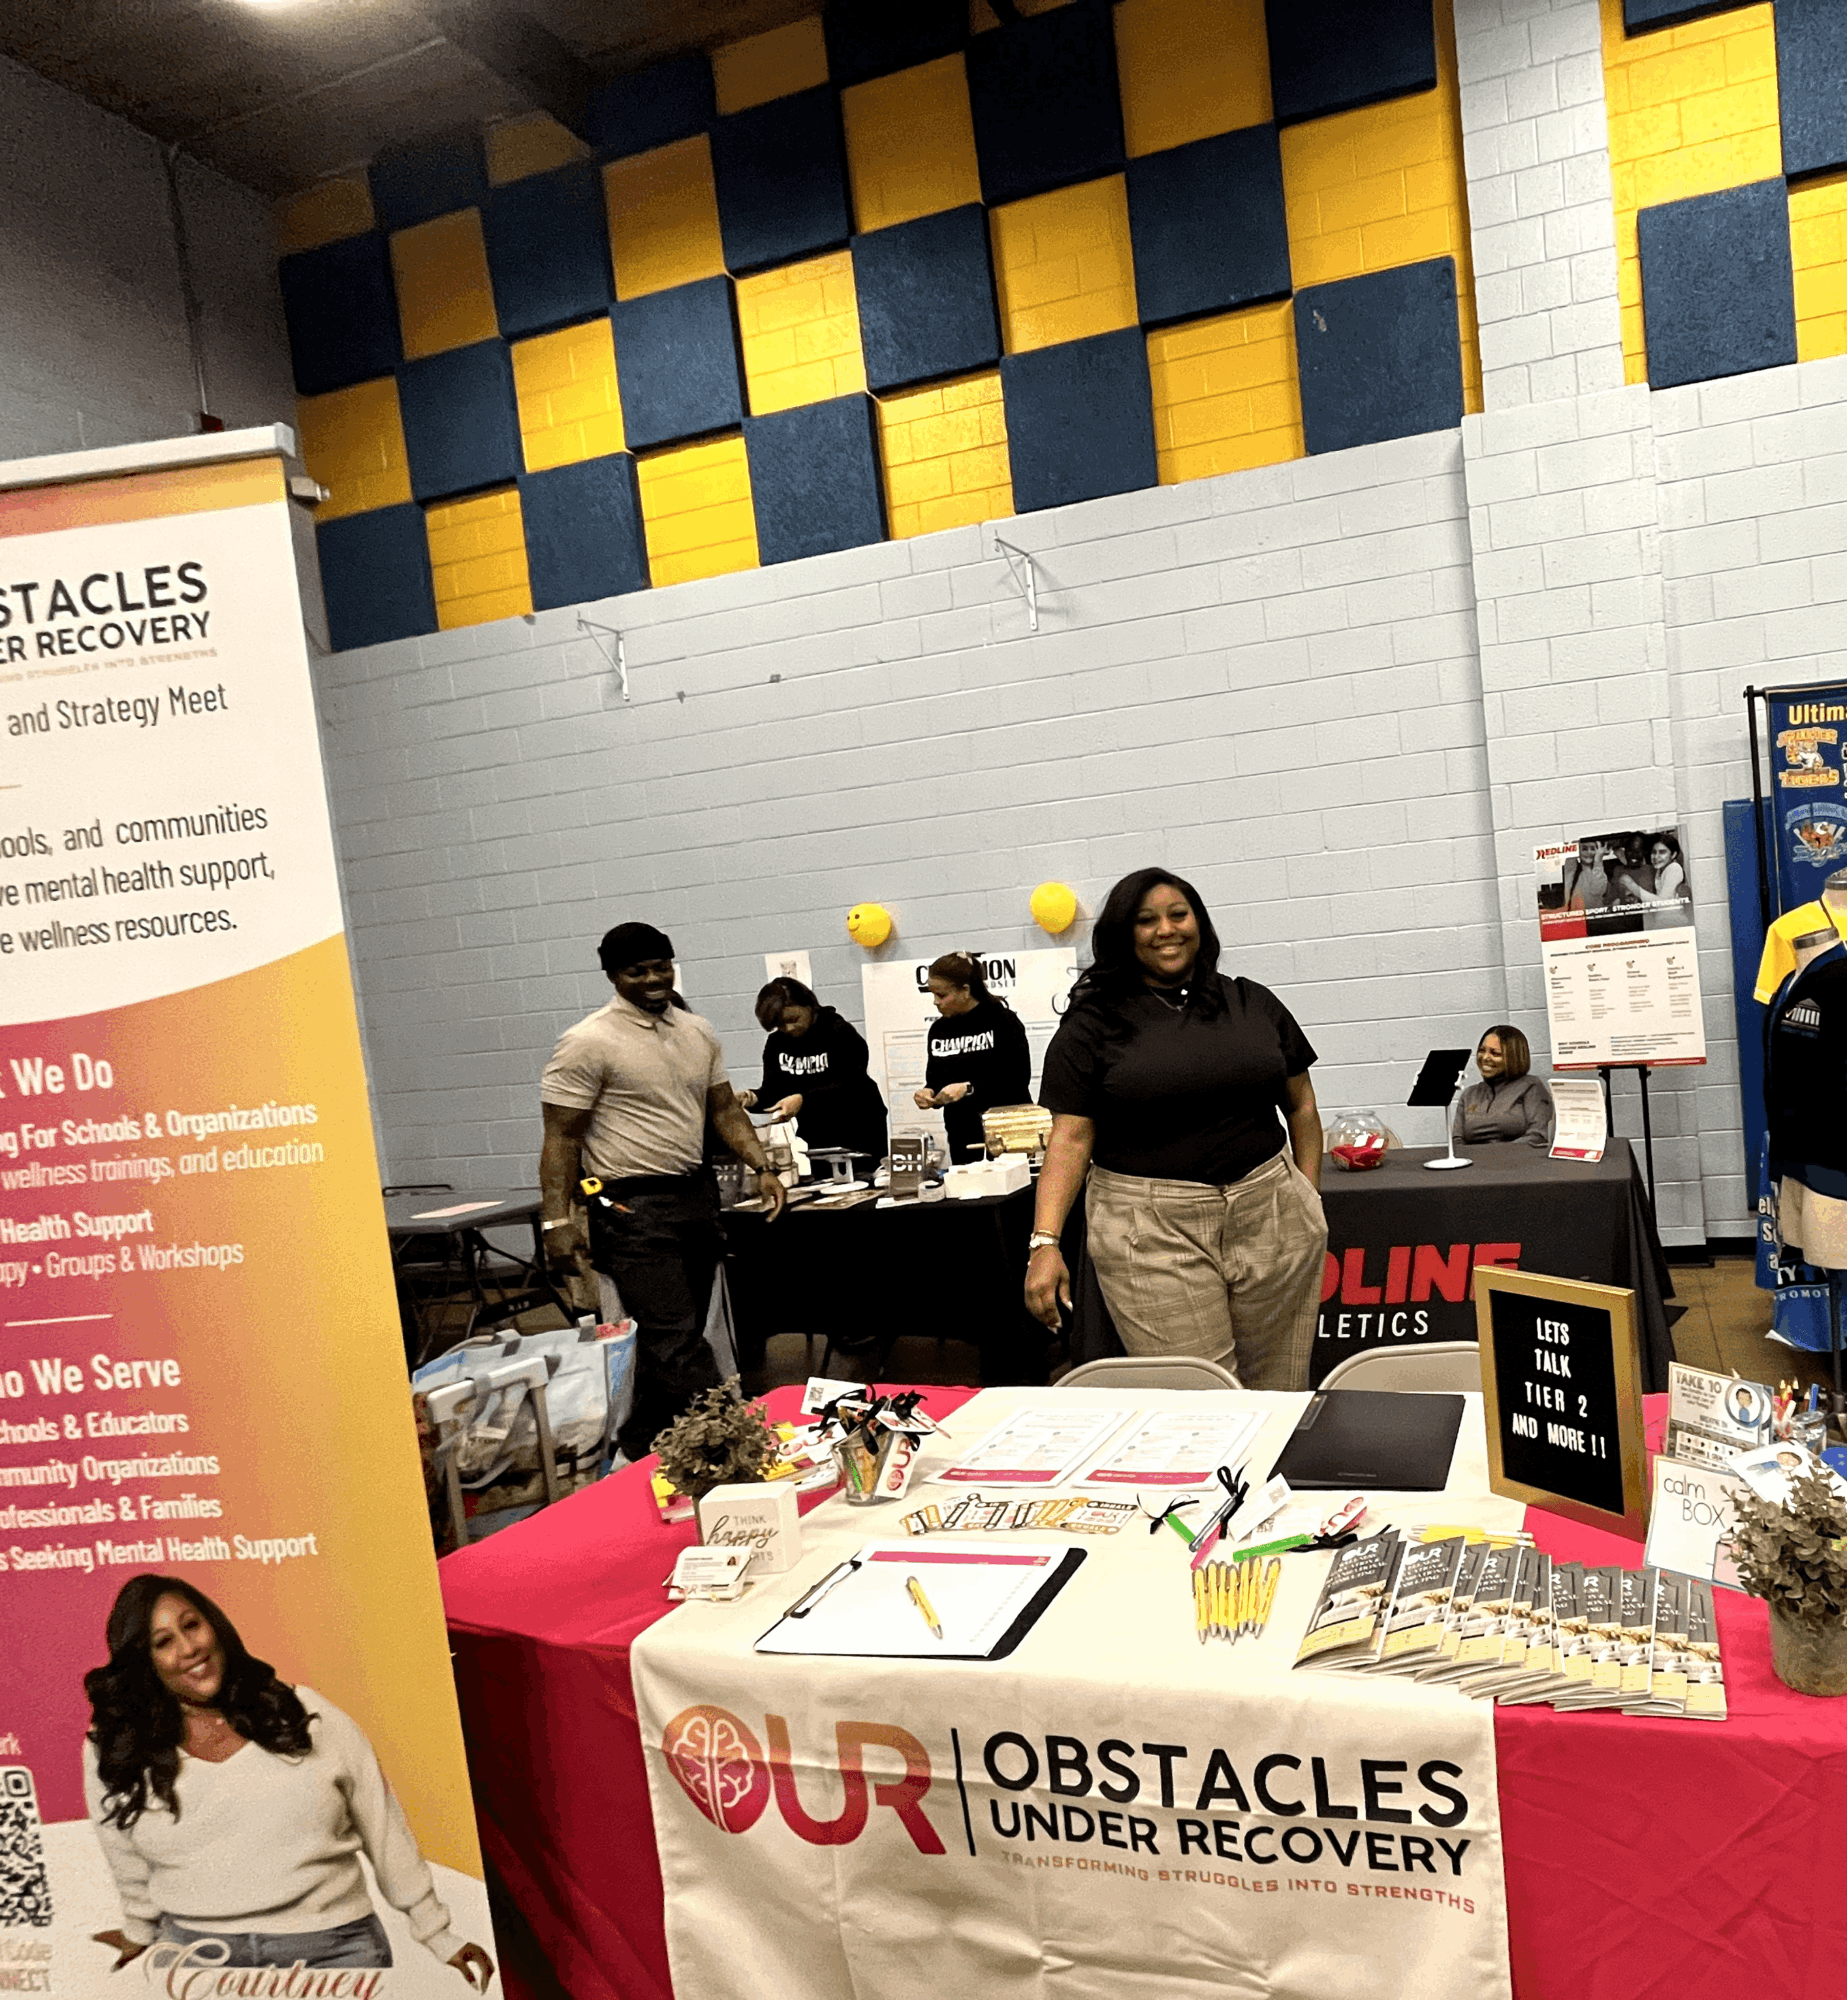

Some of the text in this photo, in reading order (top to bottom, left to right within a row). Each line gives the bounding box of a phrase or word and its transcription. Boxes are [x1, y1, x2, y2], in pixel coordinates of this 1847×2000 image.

[35, 611, 210, 659] RECOVERY
[7, 683, 229, 736] and Strategy Meet
[0, 803, 269, 859] ools, and communities
[25, 867, 99, 904] mental
[101, 860, 175, 895] health
[180, 852, 275, 891] support,
[19, 920, 111, 952] wellness
[116, 909, 238, 942] resources.
[916, 958, 1016, 986] CION
[931, 1030, 994, 1054] CHAMPION
[10, 1057, 65, 1096] We
[72, 1053, 114, 1090] Do
[21, 1123, 58, 1149] For
[62, 1114, 141, 1146] Schools
[145, 1112, 163, 1138] &
[166, 1100, 318, 1141] Organizations
[2, 1138, 323, 1190] wellness trainings, and education
[1, 1209, 154, 1244] Health Support
[46, 1251, 116, 1281] Groups
[120, 1246, 134, 1272] &
[138, 1242, 244, 1272] Workshops
[1318, 1310, 1429, 1338] LETICS
[1536, 1317, 1569, 1346] LETS
[30, 1358, 84, 1395] We
[91, 1354, 181, 1391] Serve
[1534, 1348, 1571, 1378] TALK
[1676, 1371, 1722, 1394] TAKE 10
[1524, 1381, 1588, 1418] TIER 2
[64, 1414, 83, 1439] &
[87, 1411, 189, 1437] Educators
[1512, 1412, 1538, 1439] AND
[1547, 1422, 1586, 1453] MORE
[83, 1451, 220, 1485] Organizations
[1663, 1474, 1705, 1500] calm
[119, 1496, 137, 1520] &
[140, 1493, 222, 1519] Families
[733, 1515, 766, 1525] THINK
[1683, 1499, 1726, 1529] BOX
[706, 1515, 779, 1548] happy
[10, 1544, 94, 1573] Seeking
[96, 1538, 164, 1565] Mental
[166, 1536, 230, 1560] Health
[233, 1532, 318, 1564] Support
[661, 1704, 947, 1855] OUR
[983, 1731, 1468, 1828] OBSTACLES
[990, 1799, 1471, 1876] UNDER RECOVERY
[1001, 1851, 1475, 1914] TRANSFORMING STRUGGLES INTO STRENGTHS
[143, 1937, 384, 2000] Courtney
